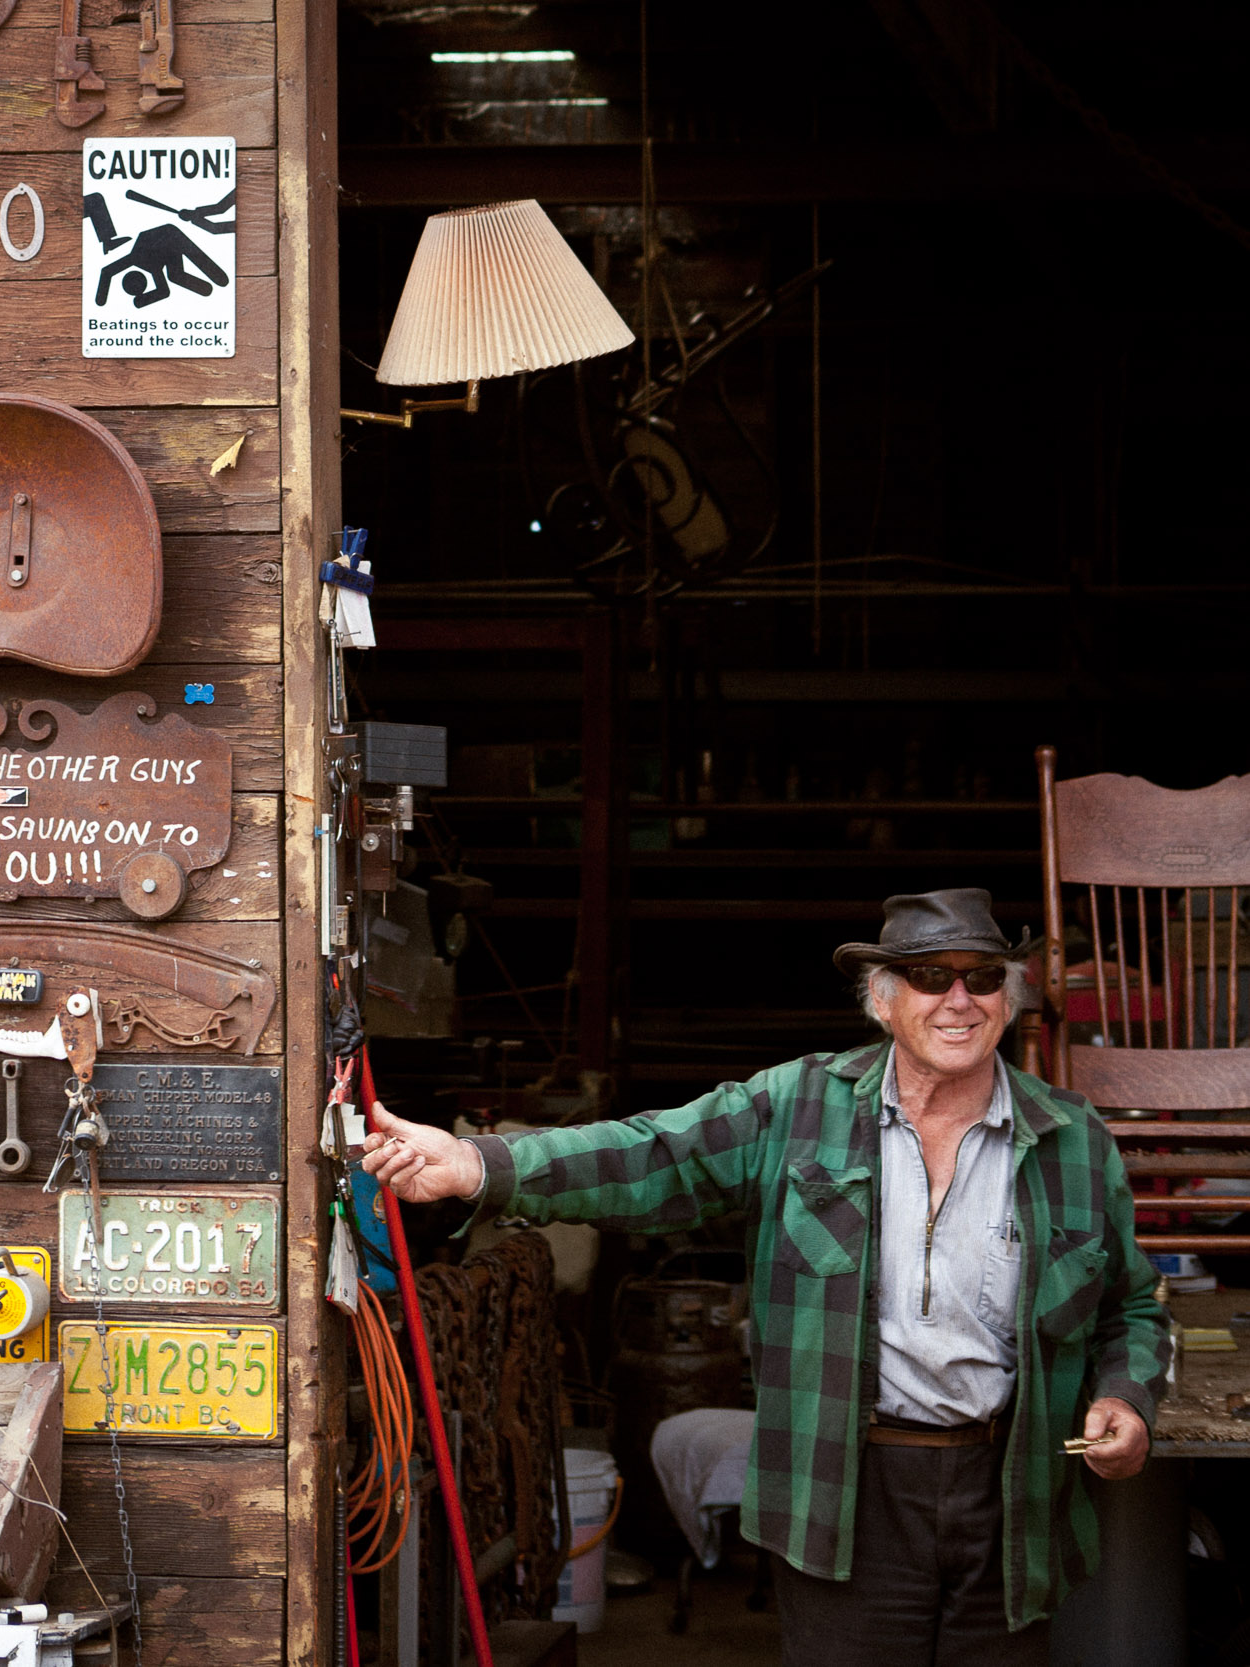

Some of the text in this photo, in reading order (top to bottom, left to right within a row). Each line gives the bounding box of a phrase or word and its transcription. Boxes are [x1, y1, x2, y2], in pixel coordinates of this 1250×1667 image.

[88, 149, 230, 180] CAUTION!
[88, 318, 229, 333] Beatings to occur
[89, 335, 228, 347] around the clock.
[26, 755, 119, 783] OTHER
[130, 757, 202, 786] GUYS
[162, 823, 199, 846] TO
[142, 1091, 204, 1104] CHIPPER
[205, 1092, 252, 1104] MODEL
[253, 1092, 272, 1104] 48
[145, 1105, 194, 1114] MFG BY
[106, 1115, 259, 1129] IPPER MACHINES &
[108, 1130, 255, 1144] NGINEERING CORP
[170, 1158, 229, 1171] OREGON
[236, 1159, 266, 1172] USA
[137, 1200, 202, 1213] TRUCK
[108, 1276, 229, 1296] COLORADO
[105, 1403, 231, 1425] FRONT BC
